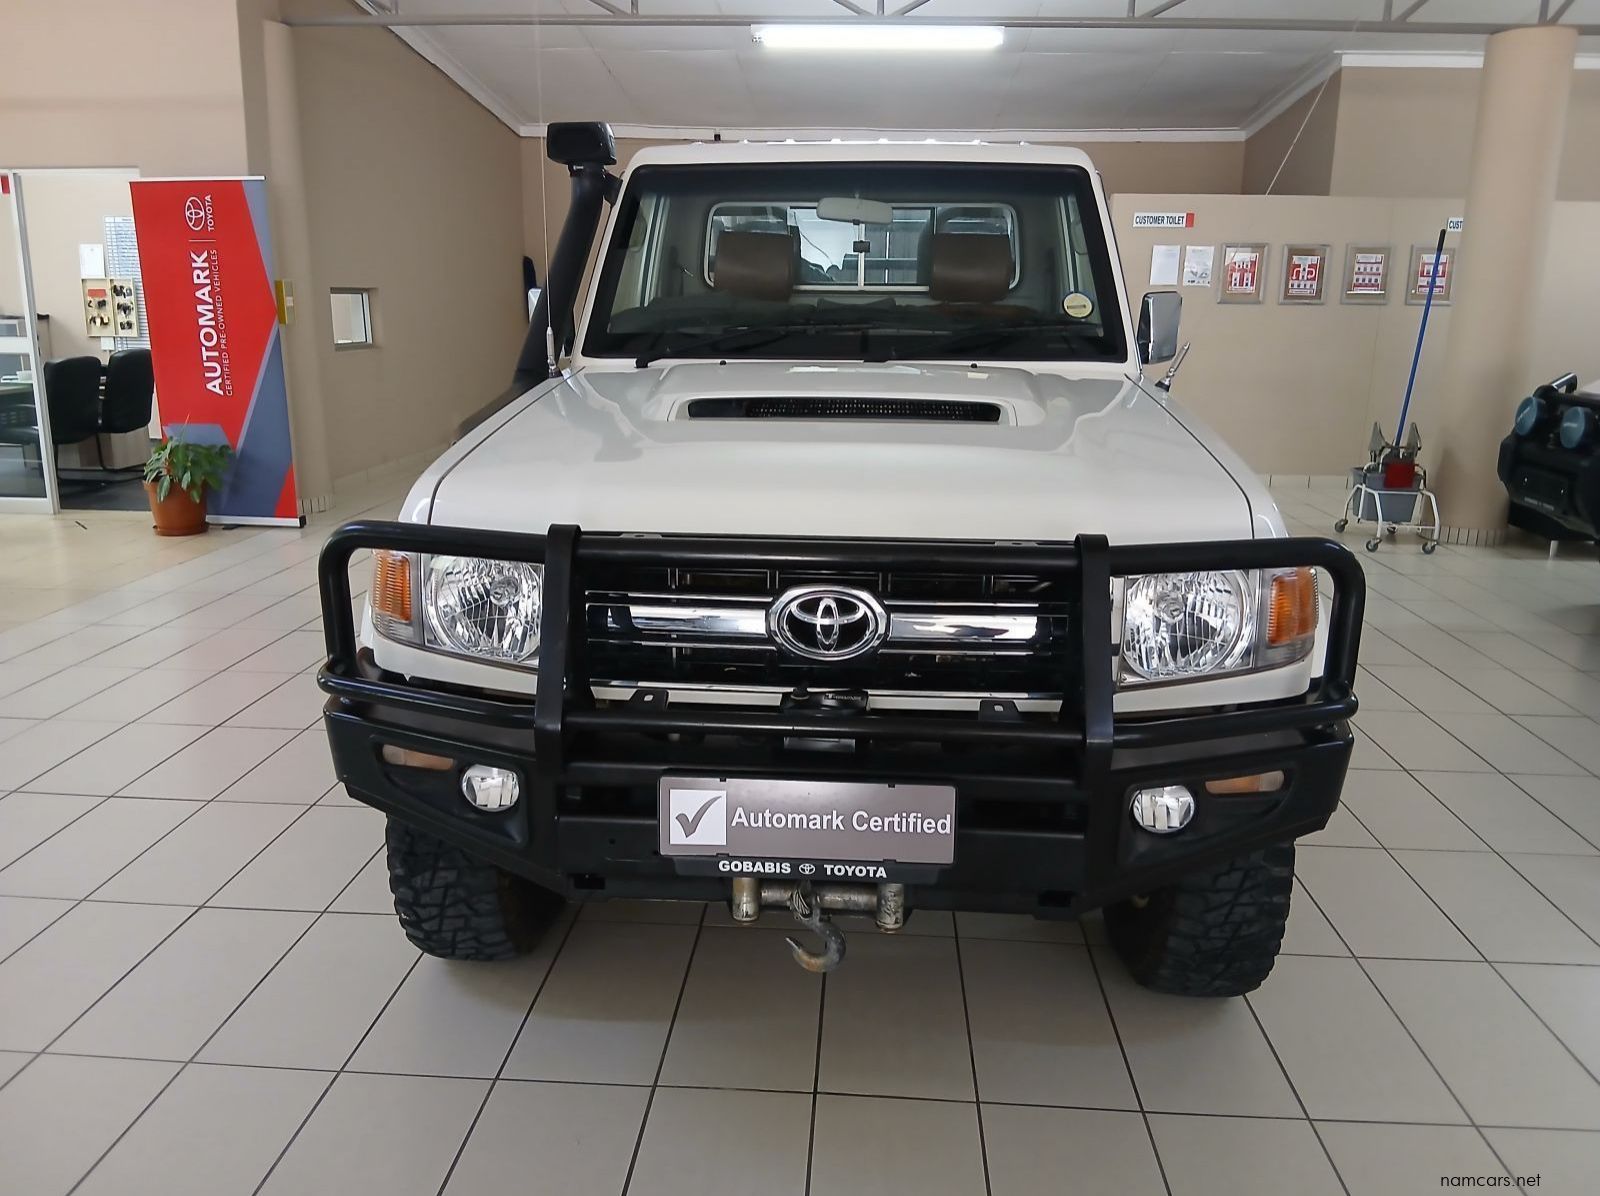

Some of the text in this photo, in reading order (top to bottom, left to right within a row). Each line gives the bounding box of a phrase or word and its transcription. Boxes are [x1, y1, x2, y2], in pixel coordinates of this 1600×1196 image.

[205, 194, 214, 232] TOYOTA
[1135, 215, 1185, 225] CUSTOMER TOILET
[190, 250, 224, 396] AUTOMARK
[210, 249, 233, 396] CERTIFIED PRE-OWNED VEHICLES
[731, 807, 951, 835] Automark Certified
[718, 859, 887, 879] GOBABIS TOYOTA
